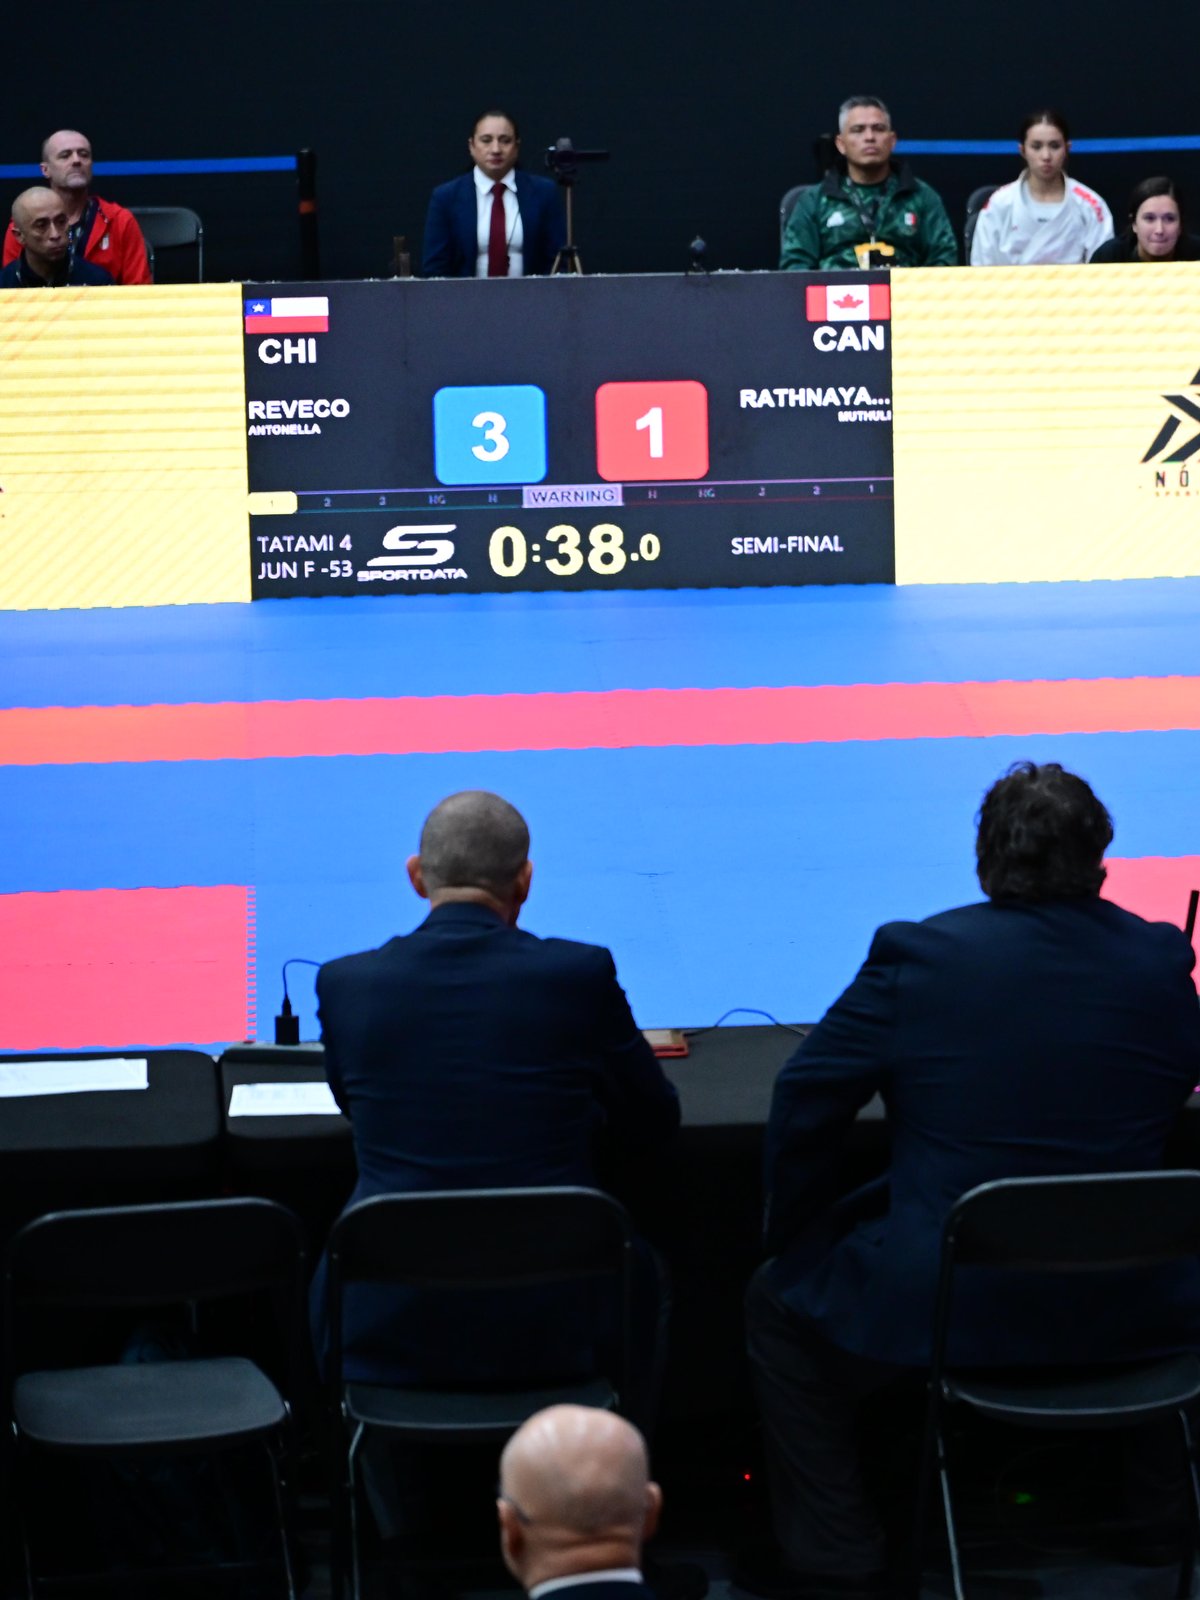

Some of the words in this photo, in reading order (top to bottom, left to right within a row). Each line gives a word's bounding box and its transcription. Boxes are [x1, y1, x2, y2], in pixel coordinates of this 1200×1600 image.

[812, 324, 885, 353] CAN
[257, 337, 317, 365] CHI
[739, 386, 891, 409] RATHNAYA...
[248, 398, 351, 420] REVECO
[837, 410, 892, 423] MUTHULI
[247, 423, 322, 436] ANTONELLA
[471, 411, 510, 462] 3
[635, 407, 664, 458] 1
[532, 490, 615, 503] WARNING
[256, 535, 334, 553] TATAMI
[338, 534, 353, 551] 4
[488, 523, 661, 577] 0:38.0
[731, 535, 844, 555] SEMI-FINAL
[257, 561, 298, 580] JUN
[303, 560, 316, 578] F
[320, 559, 354, 578] -53
[356, 567, 469, 582] SPORTDATA
